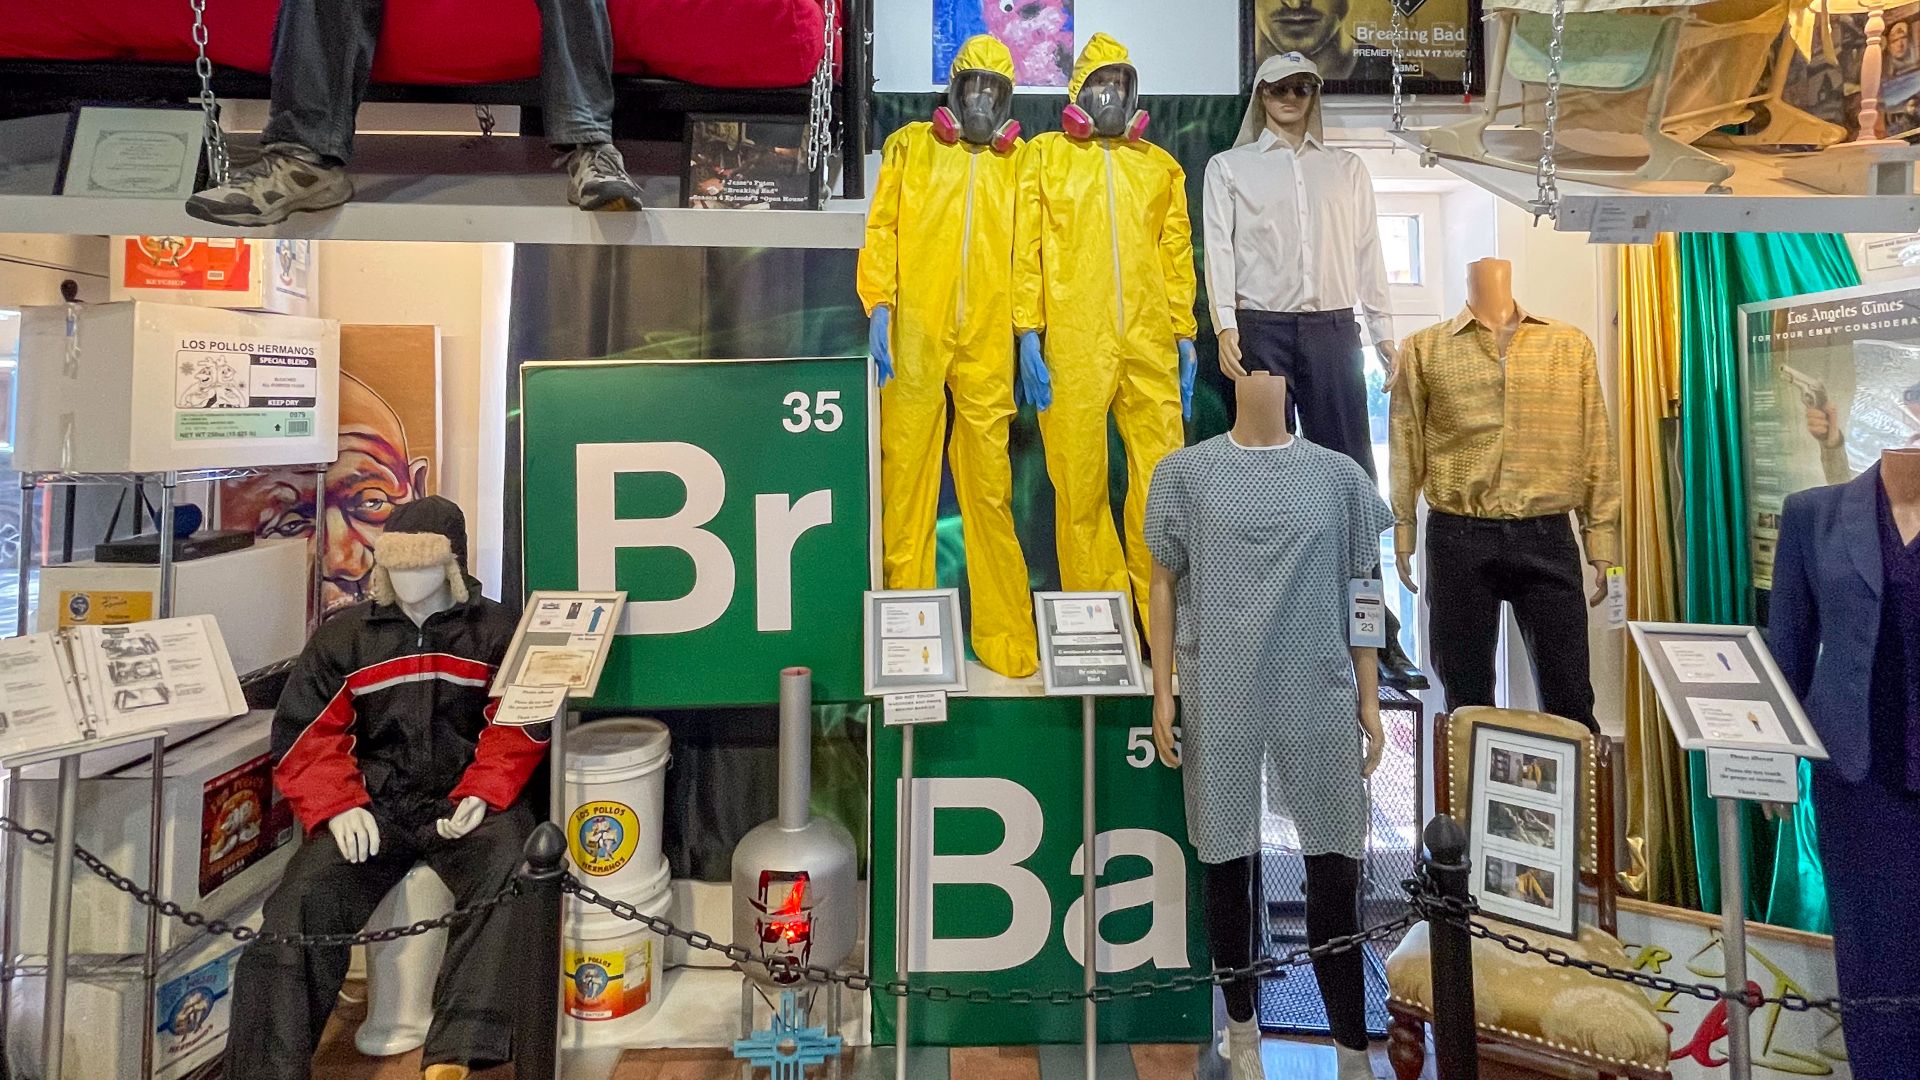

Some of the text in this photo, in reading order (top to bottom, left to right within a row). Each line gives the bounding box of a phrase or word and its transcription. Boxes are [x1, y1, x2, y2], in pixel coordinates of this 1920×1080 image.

[1356, 27, 1465, 44] Breaing Bad
[1406, 49, 1430, 57] JULY
[1432, 49, 1440, 57] 17
[1787, 300, 1904, 325] Los Angeles Times
[1776, 330, 1803, 340] YOUR
[182, 340, 314, 356] LOS POLLOS HERMANOS
[259, 357, 308, 366] SPECIAL BLEND
[782, 391, 844, 433] 35
[576, 443, 832, 634] Br
[1361, 623, 1374, 632] 23
[576, 806, 626, 821] LOS POLLOS
[582, 856, 626, 872] HERMANOS
[896, 777, 1191, 972] Ba
[574, 956, 611, 968] LOS POLLOS
